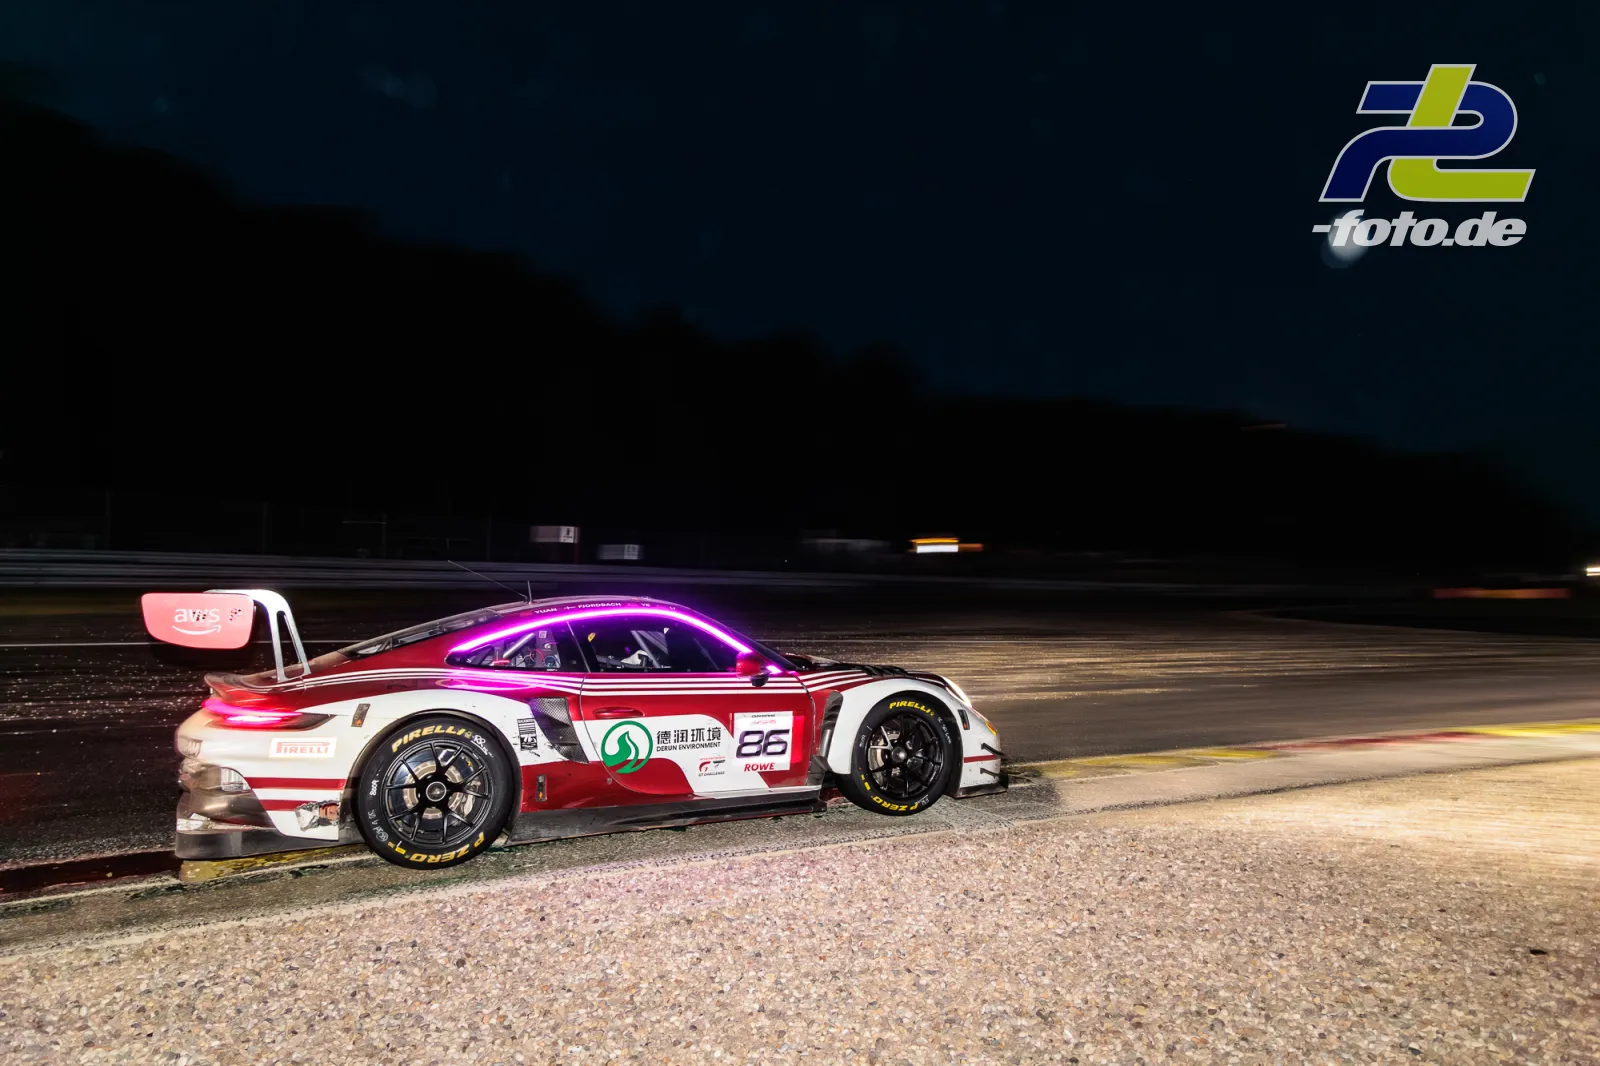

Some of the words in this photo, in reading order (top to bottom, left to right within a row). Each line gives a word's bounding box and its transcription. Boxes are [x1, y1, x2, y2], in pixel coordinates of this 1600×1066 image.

[174, 608, 221, 623] aws
[889, 700, 932, 714] PIRELLI
[391, 724, 467, 753] PIRELLI
[656, 727, 721, 745] 德润环境
[275, 741, 331, 754] PIRELLI
[656, 744, 678, 752] DERUN
[678, 742, 721, 751] ENVIRONMENT
[736, 729, 790, 759] 86
[744, 763, 775, 772] ROWE
[872, 795, 908, 812] ZERO
[909, 802, 919, 811] P
[473, 832, 485, 848] P
[409, 844, 470, 864] ZERO
